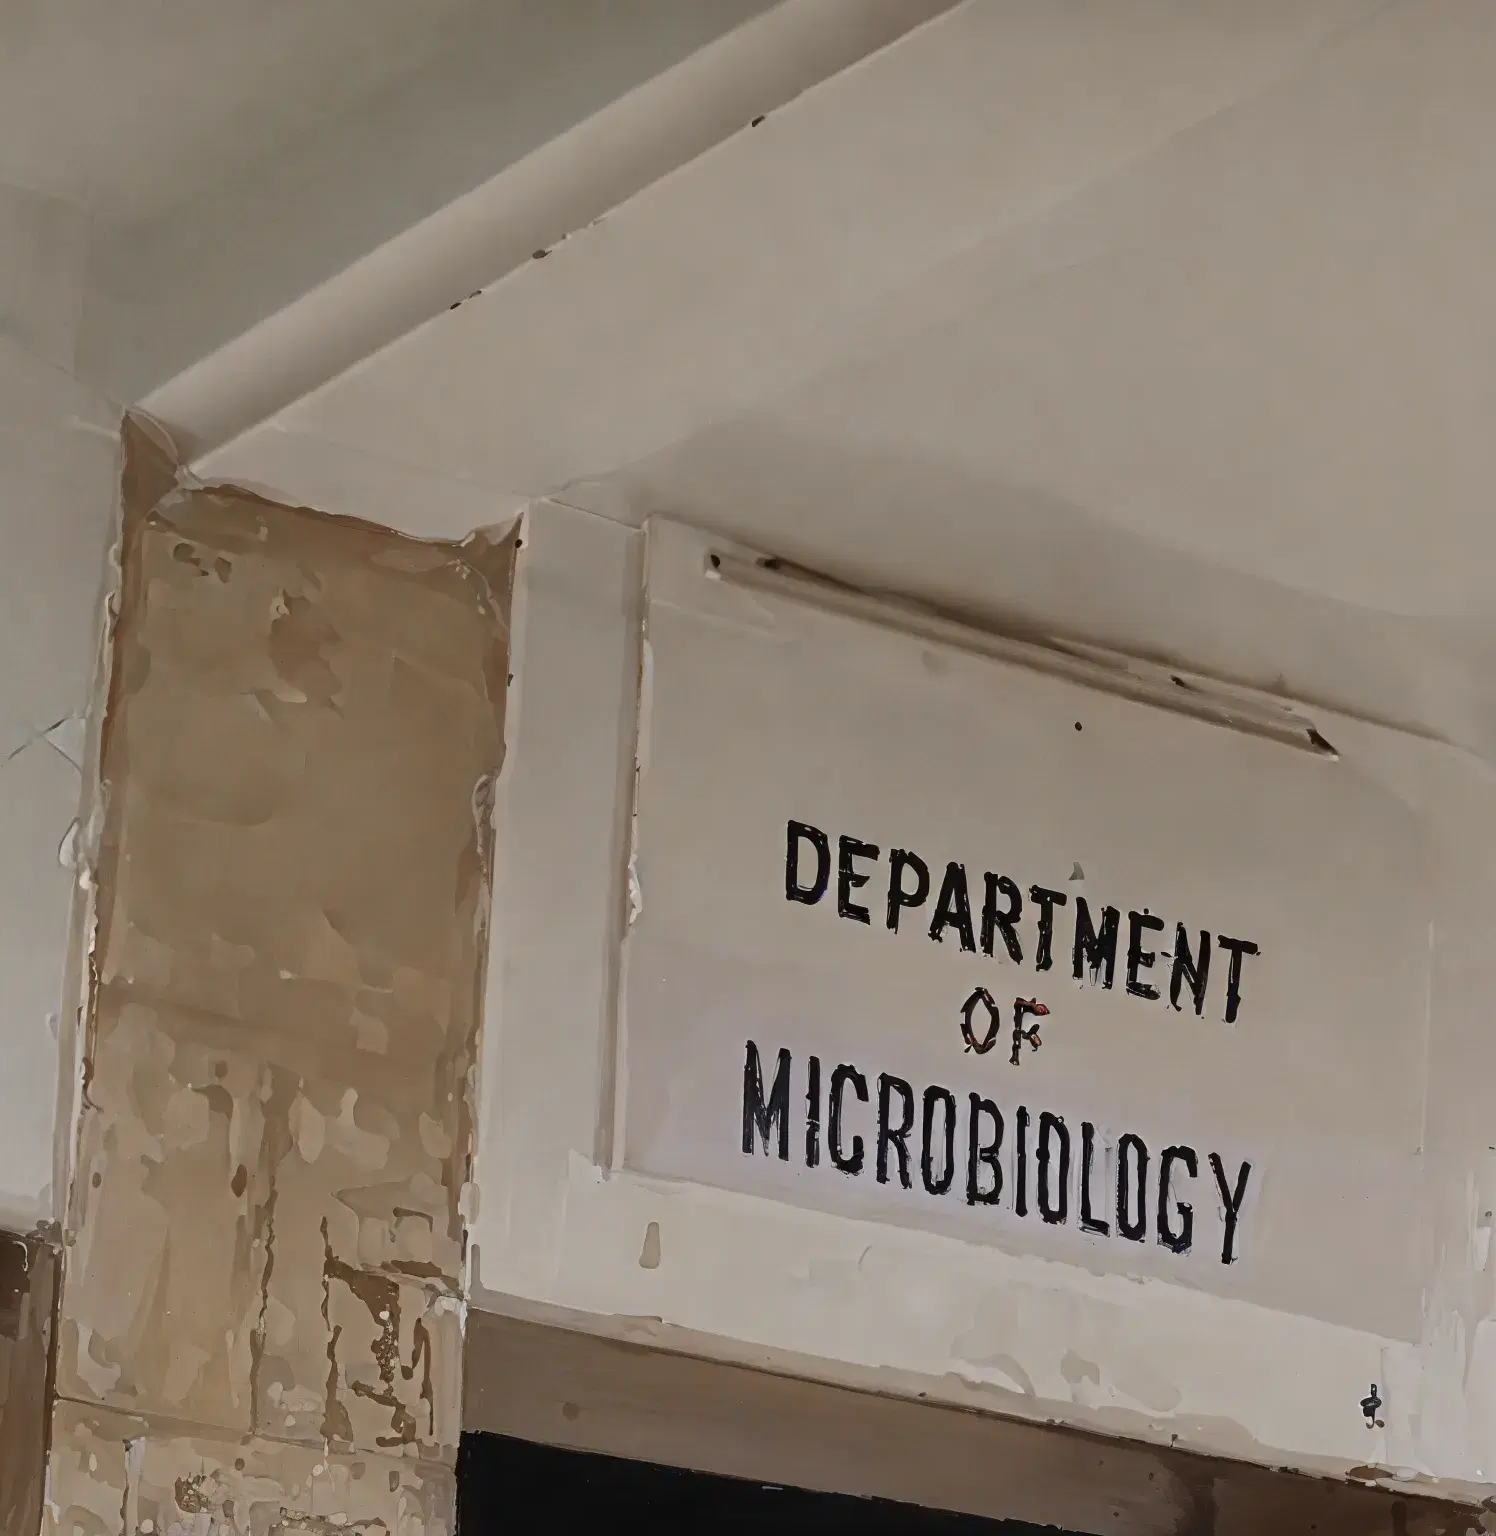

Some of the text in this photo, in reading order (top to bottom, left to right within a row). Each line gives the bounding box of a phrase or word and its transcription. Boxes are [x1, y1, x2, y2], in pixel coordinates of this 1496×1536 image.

[785, 819, 1262, 1024] DEPARTMENT
[959, 986, 1051, 1066] OF
[741, 1039, 1254, 1266] MICROBIOLOGY
